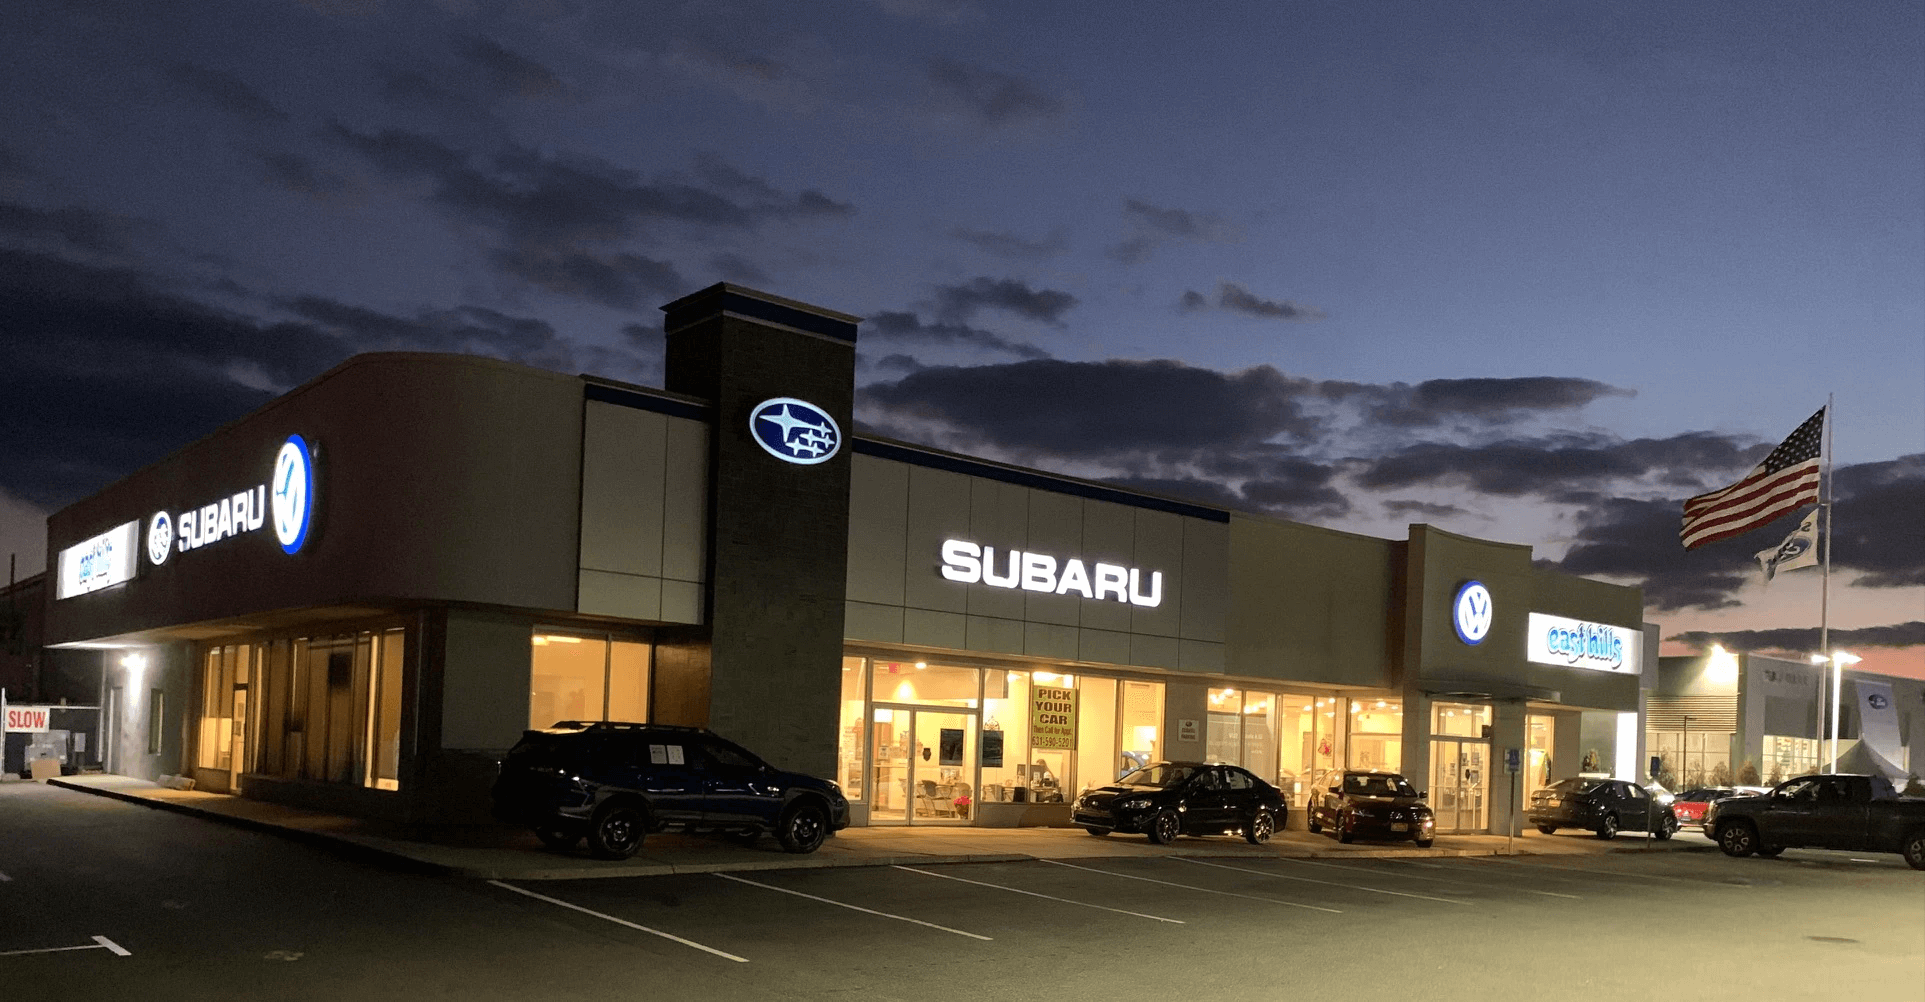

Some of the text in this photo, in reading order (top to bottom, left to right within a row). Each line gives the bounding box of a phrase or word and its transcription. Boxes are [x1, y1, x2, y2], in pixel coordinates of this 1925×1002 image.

[178, 484, 265, 552] SUBARU
[941, 539, 1162, 607] SUBARU
[1547, 623, 1623, 670] east hills
[1038, 688, 1071, 700] PICK
[1035, 701, 1072, 713] YOUR
[9, 710, 46, 728] SLOW
[1040, 714, 1067, 725] CAR
[1045, 725, 1053, 734] Call
